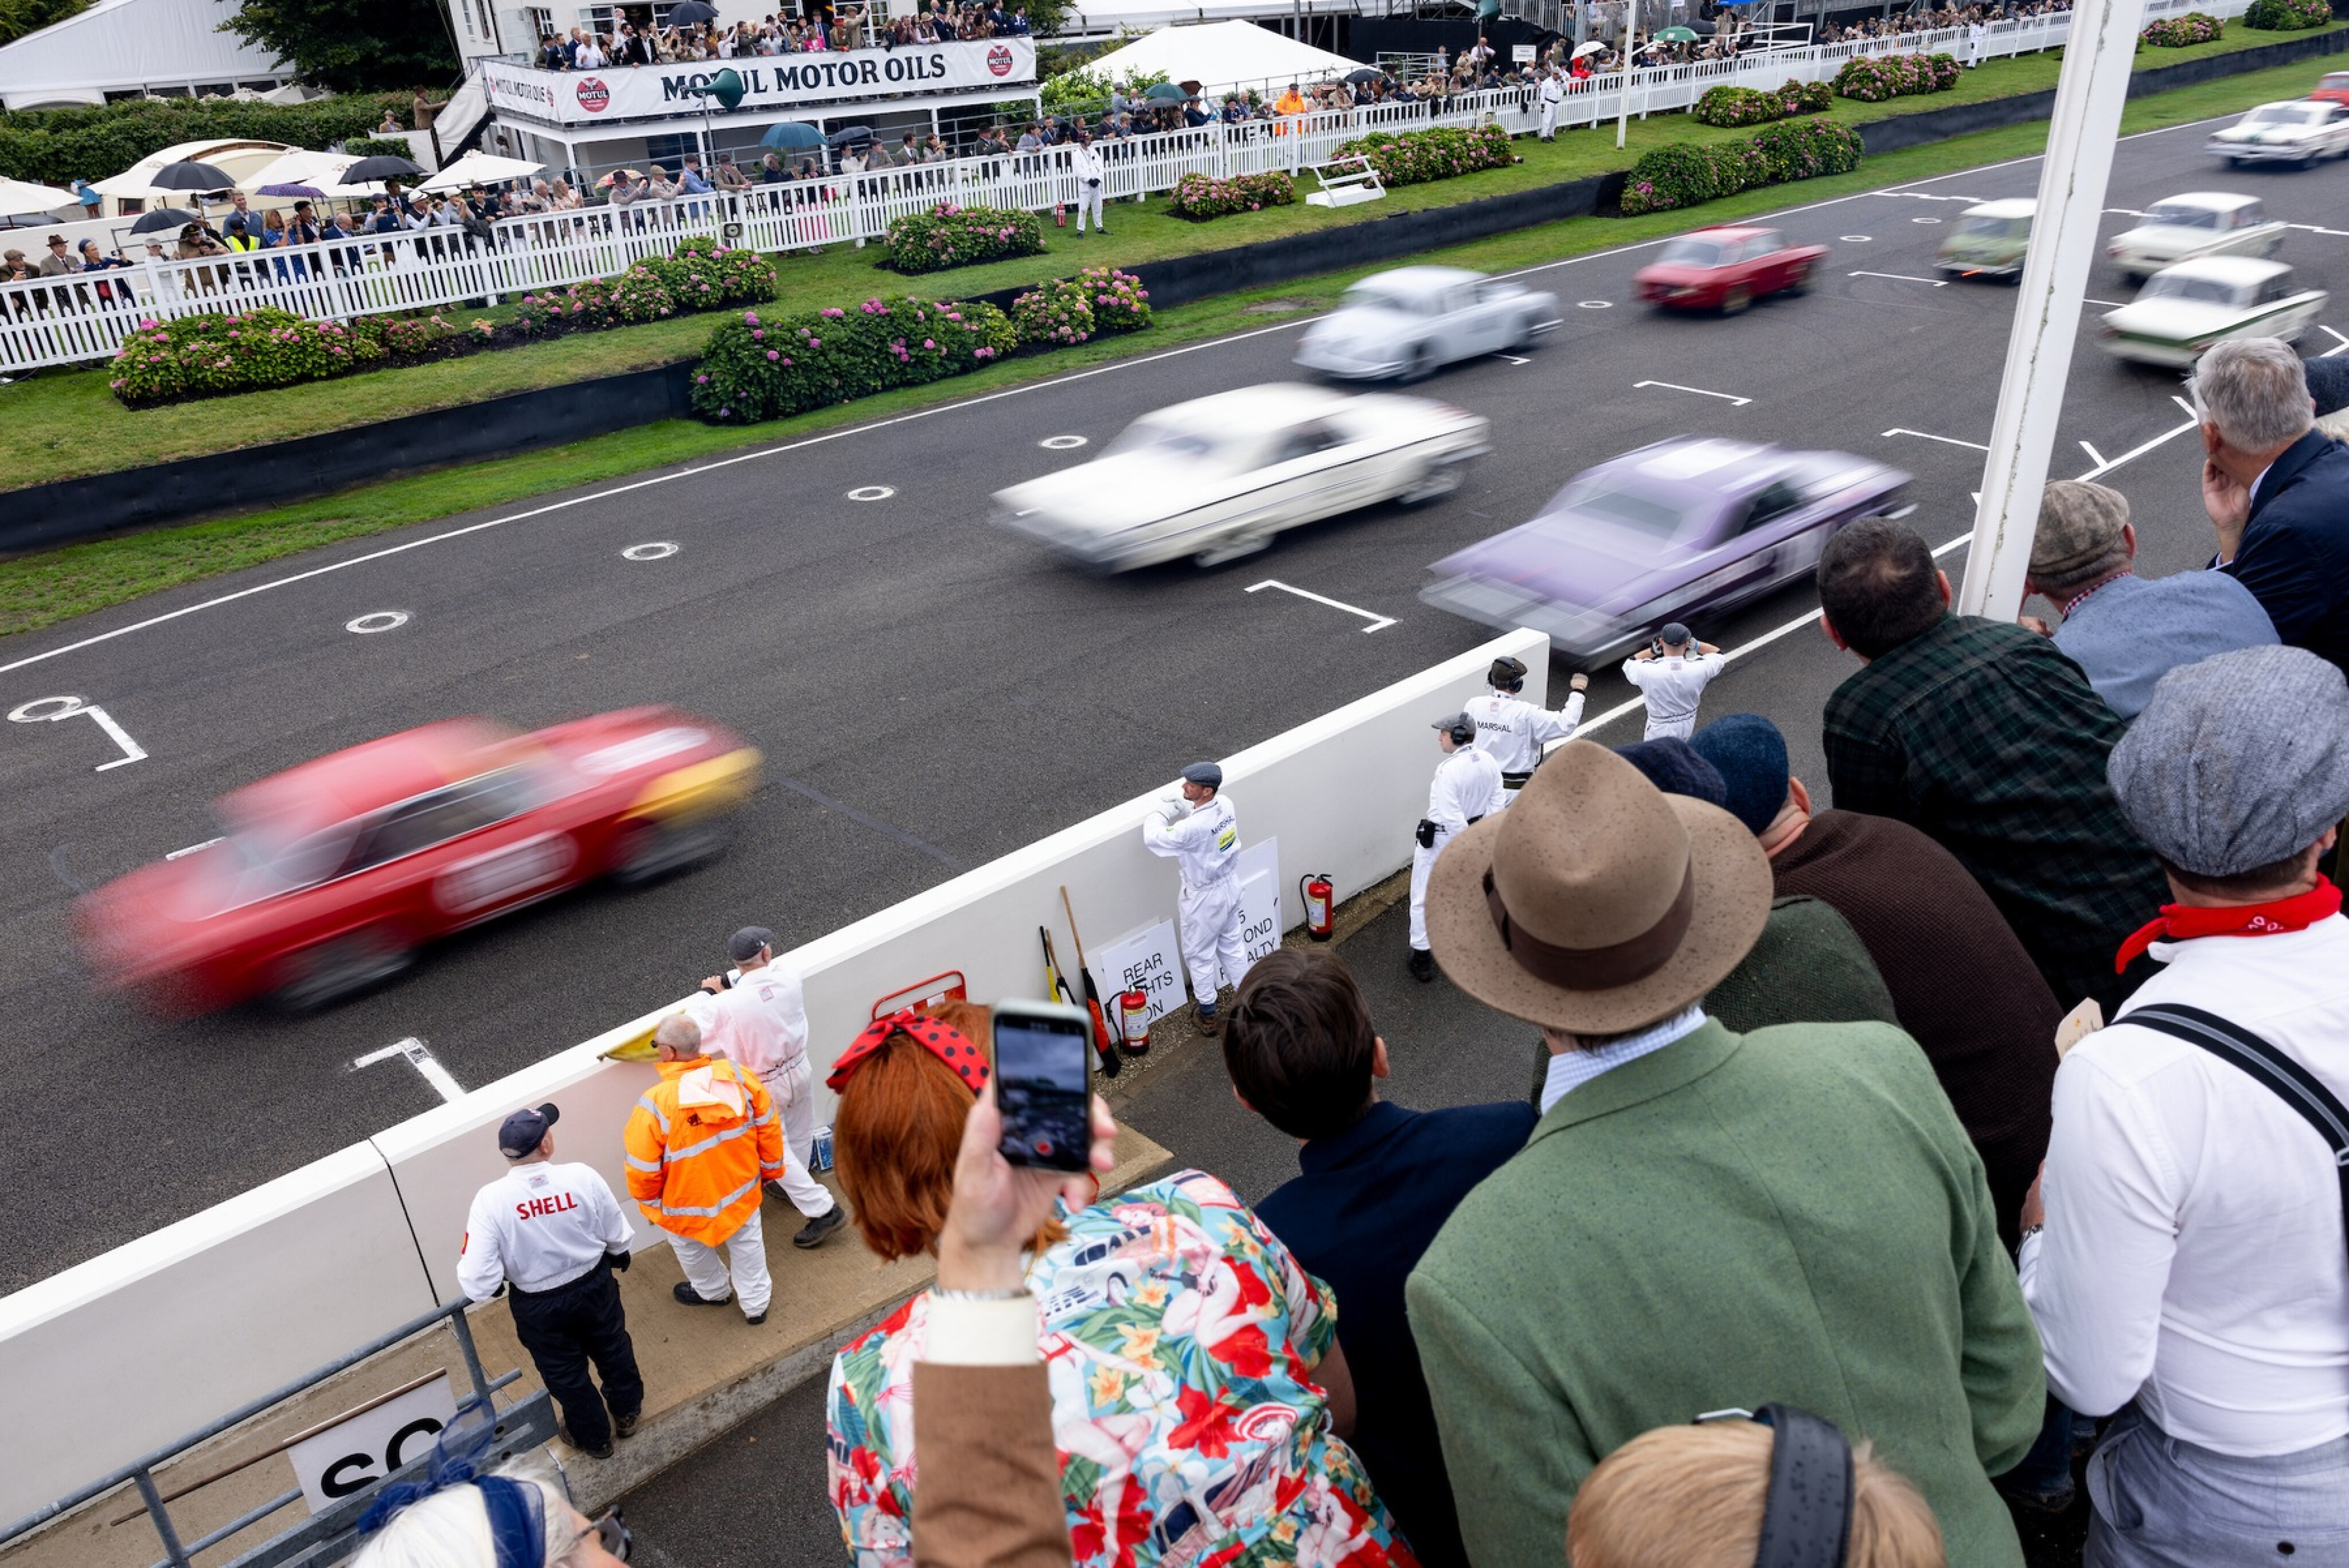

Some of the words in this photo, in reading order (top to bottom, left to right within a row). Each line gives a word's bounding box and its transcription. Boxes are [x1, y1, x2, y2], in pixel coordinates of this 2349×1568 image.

[774, 59, 880, 91] MOTOR
[884, 54, 946, 81] OILS
[577, 90, 609, 100] MOTUL
[1243, 918, 1273, 944] OND
[1123, 953, 1163, 984] REAR
[1145, 971, 1173, 997] HTS
[516, 1192, 578, 1220] SHELL
